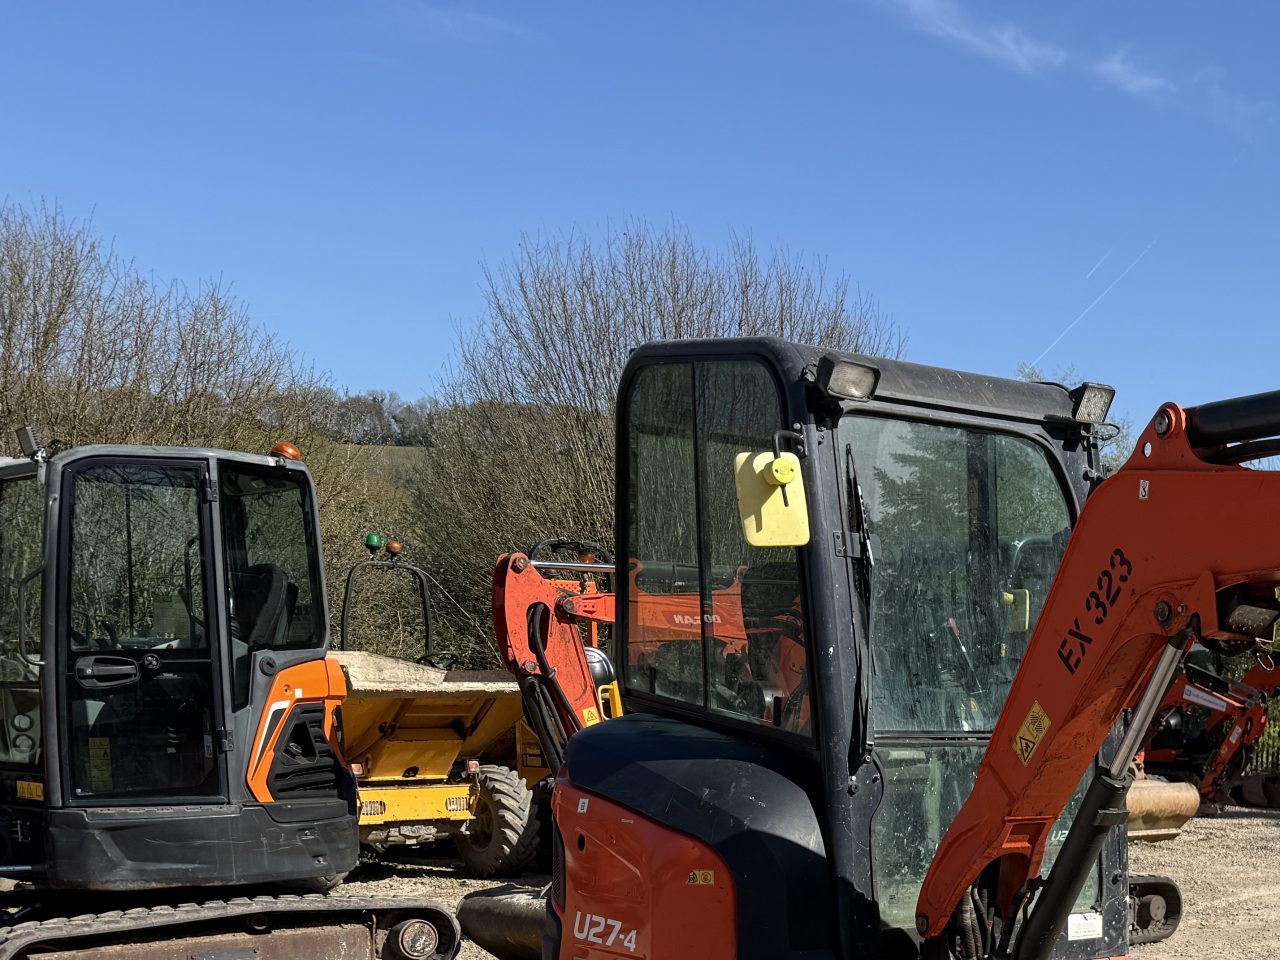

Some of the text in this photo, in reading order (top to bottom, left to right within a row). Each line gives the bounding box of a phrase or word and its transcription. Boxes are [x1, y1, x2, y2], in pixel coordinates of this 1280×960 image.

[1057, 548, 1132, 676] EX 323
[573, 911, 637, 952] U27-4
